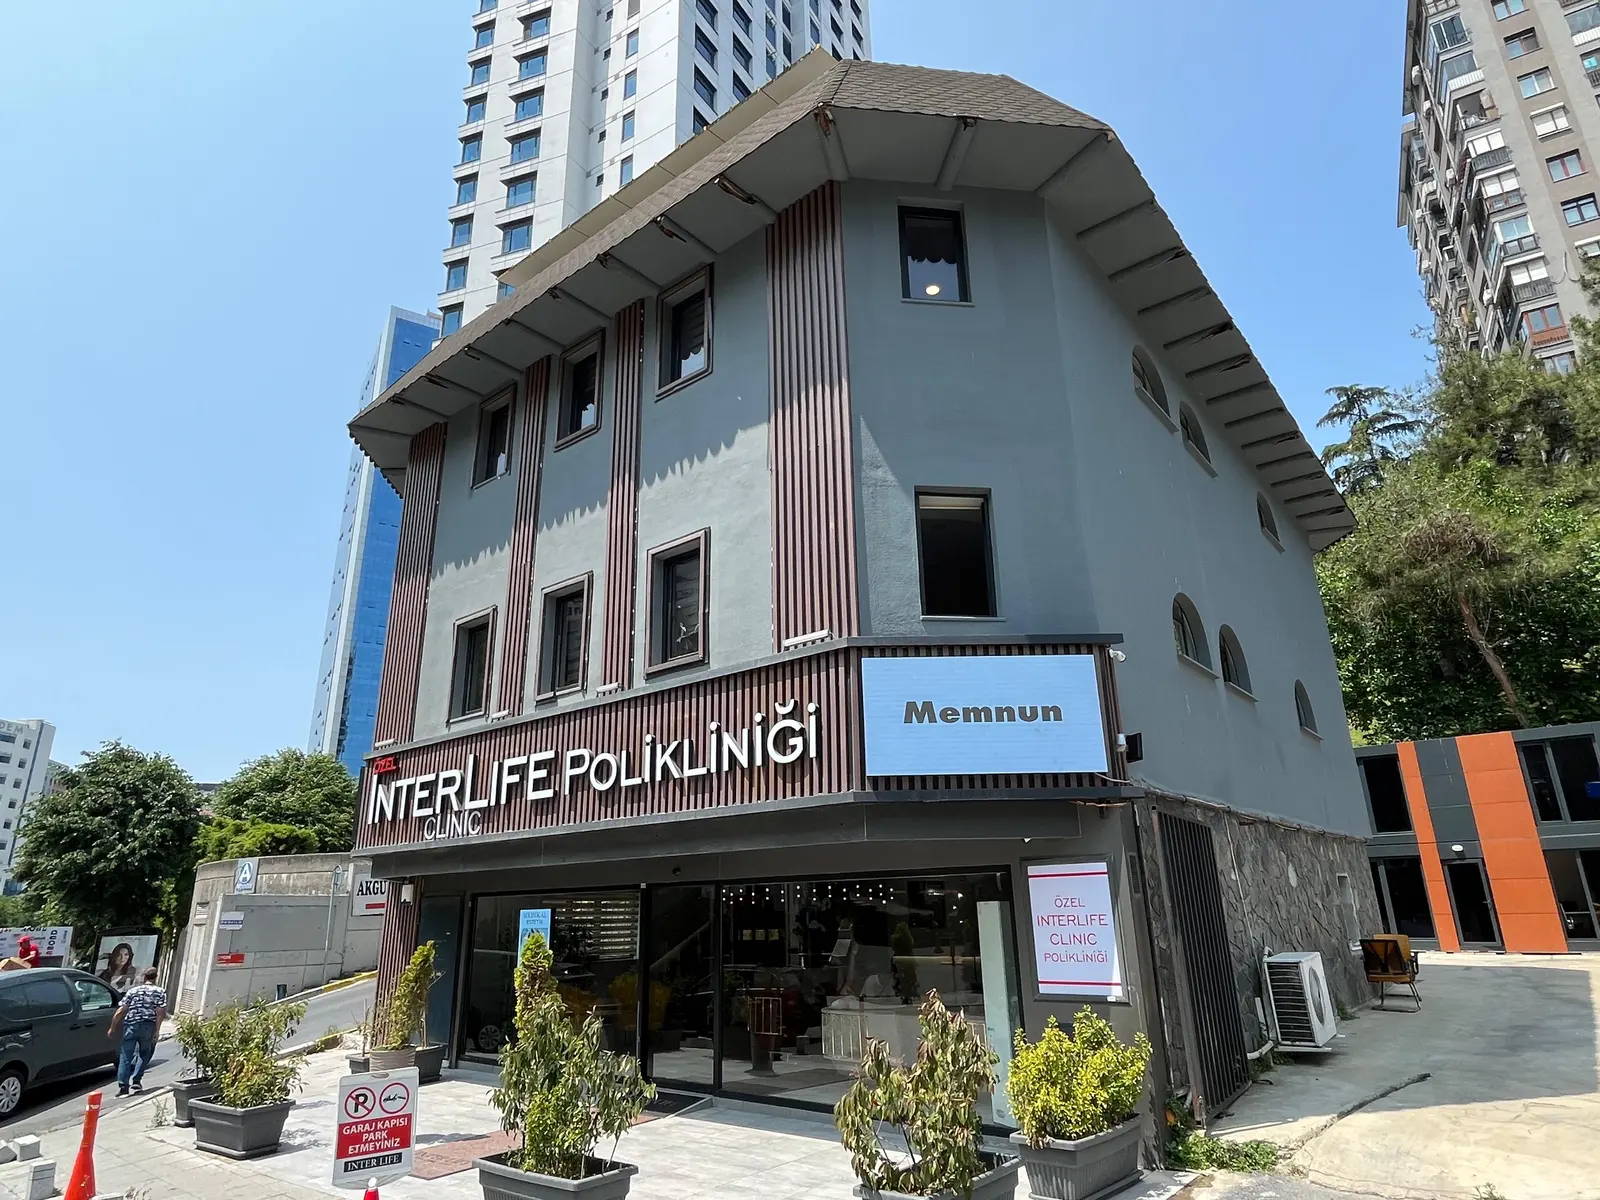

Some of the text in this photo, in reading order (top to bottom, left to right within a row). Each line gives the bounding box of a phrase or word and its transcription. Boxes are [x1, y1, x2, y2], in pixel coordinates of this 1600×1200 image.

[903, 701, 1063, 724] Memnun
[564, 699, 820, 796] POLİKLİNİĞİ
[374, 755, 397, 775] ÖZEL
[423, 810, 482, 840] CLINIC
[1054, 894, 1086, 908] ÖZEL
[1037, 914, 1108, 927] INTERLIFE
[1049, 933, 1098, 946] CLINIC
[1044, 950, 1108, 963] POLİKLİNİĞİ
[343, 1117, 408, 1135] GARAJ KAPISI
[362, 1130, 388, 1142] PARK
[348, 1138, 400, 1155] ETMEYİNİZ
[347, 1154, 400, 1171] INTER LIFE
